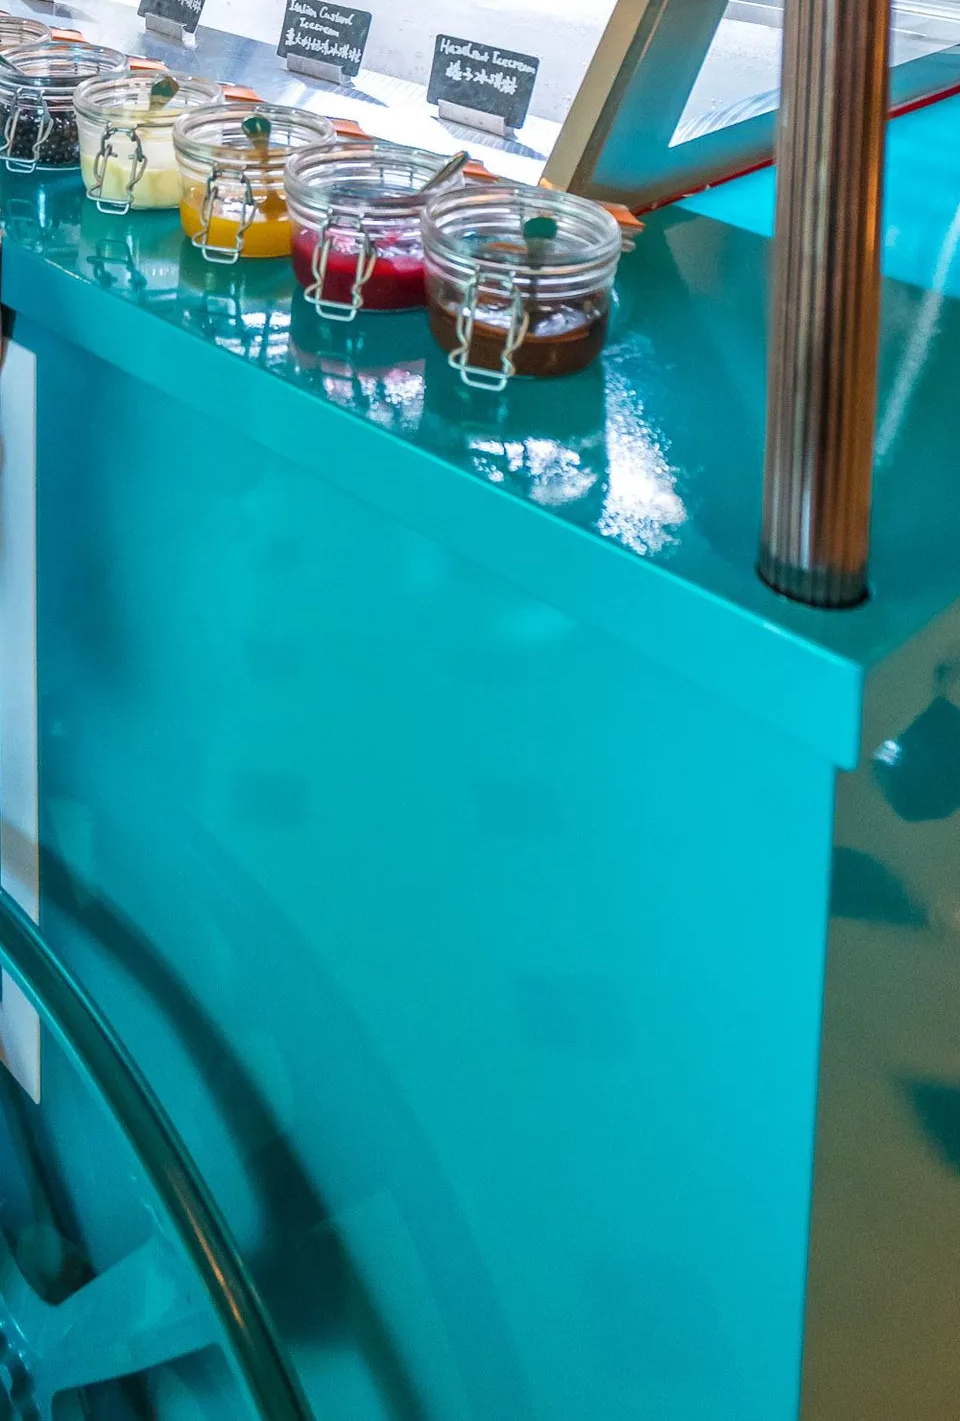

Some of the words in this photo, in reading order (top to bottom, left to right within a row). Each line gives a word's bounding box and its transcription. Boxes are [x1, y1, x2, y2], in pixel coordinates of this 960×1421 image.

[319, 6, 355, 26] Custard
[299, 17, 340, 37] Icecream
[440, 37, 490, 62] Hazelnut
[492, 50, 536, 74] Icecream
